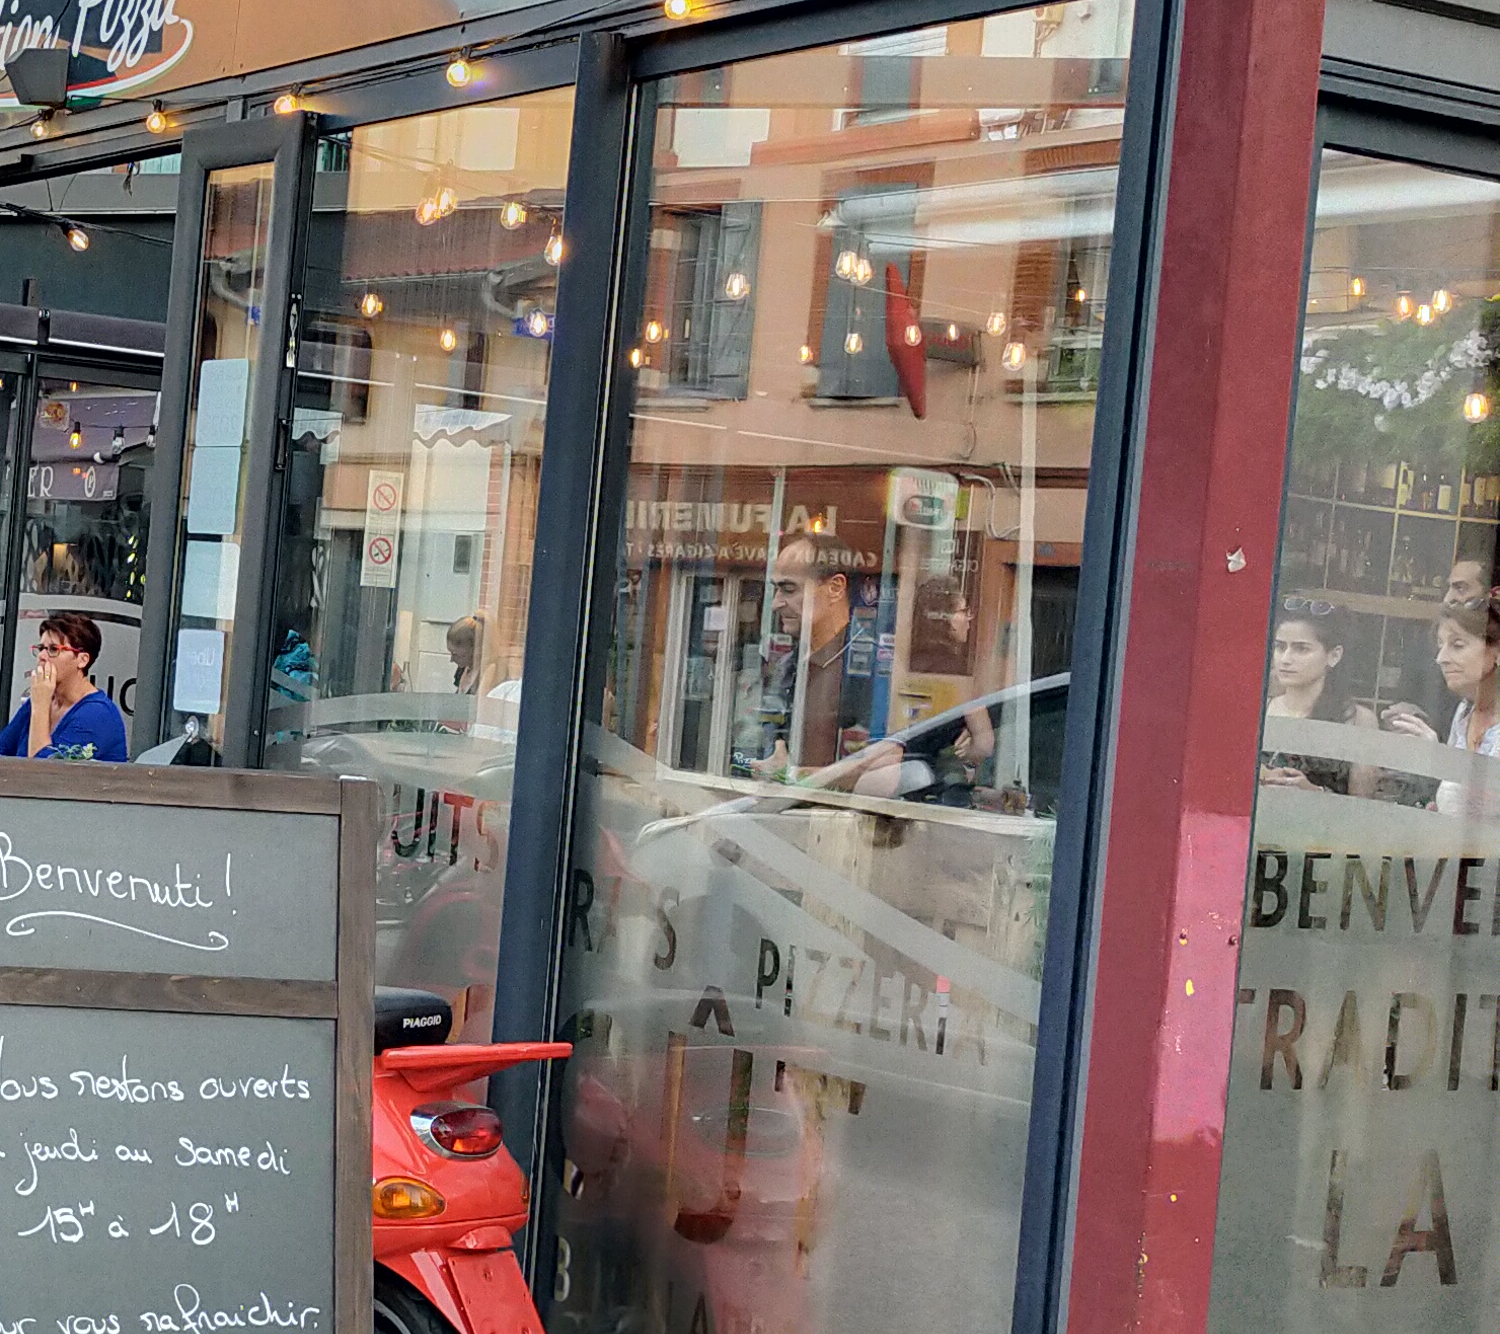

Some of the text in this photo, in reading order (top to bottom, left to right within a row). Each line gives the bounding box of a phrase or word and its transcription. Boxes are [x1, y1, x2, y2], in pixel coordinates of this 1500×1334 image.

[224, 854, 238, 917] !
[1251, 849, 1500, 937] BENVE
[403, 1015, 442, 1029] PIAGGIO
[70, 1055, 184, 1102] restons
[199, 1064, 310, 1101] ouverts
[15, 1127, 98, 1195] jeudi
[115, 1142, 152, 1165] au
[108, 1213, 129, 1240] à
[1318, 1148, 1457, 1289] LA
